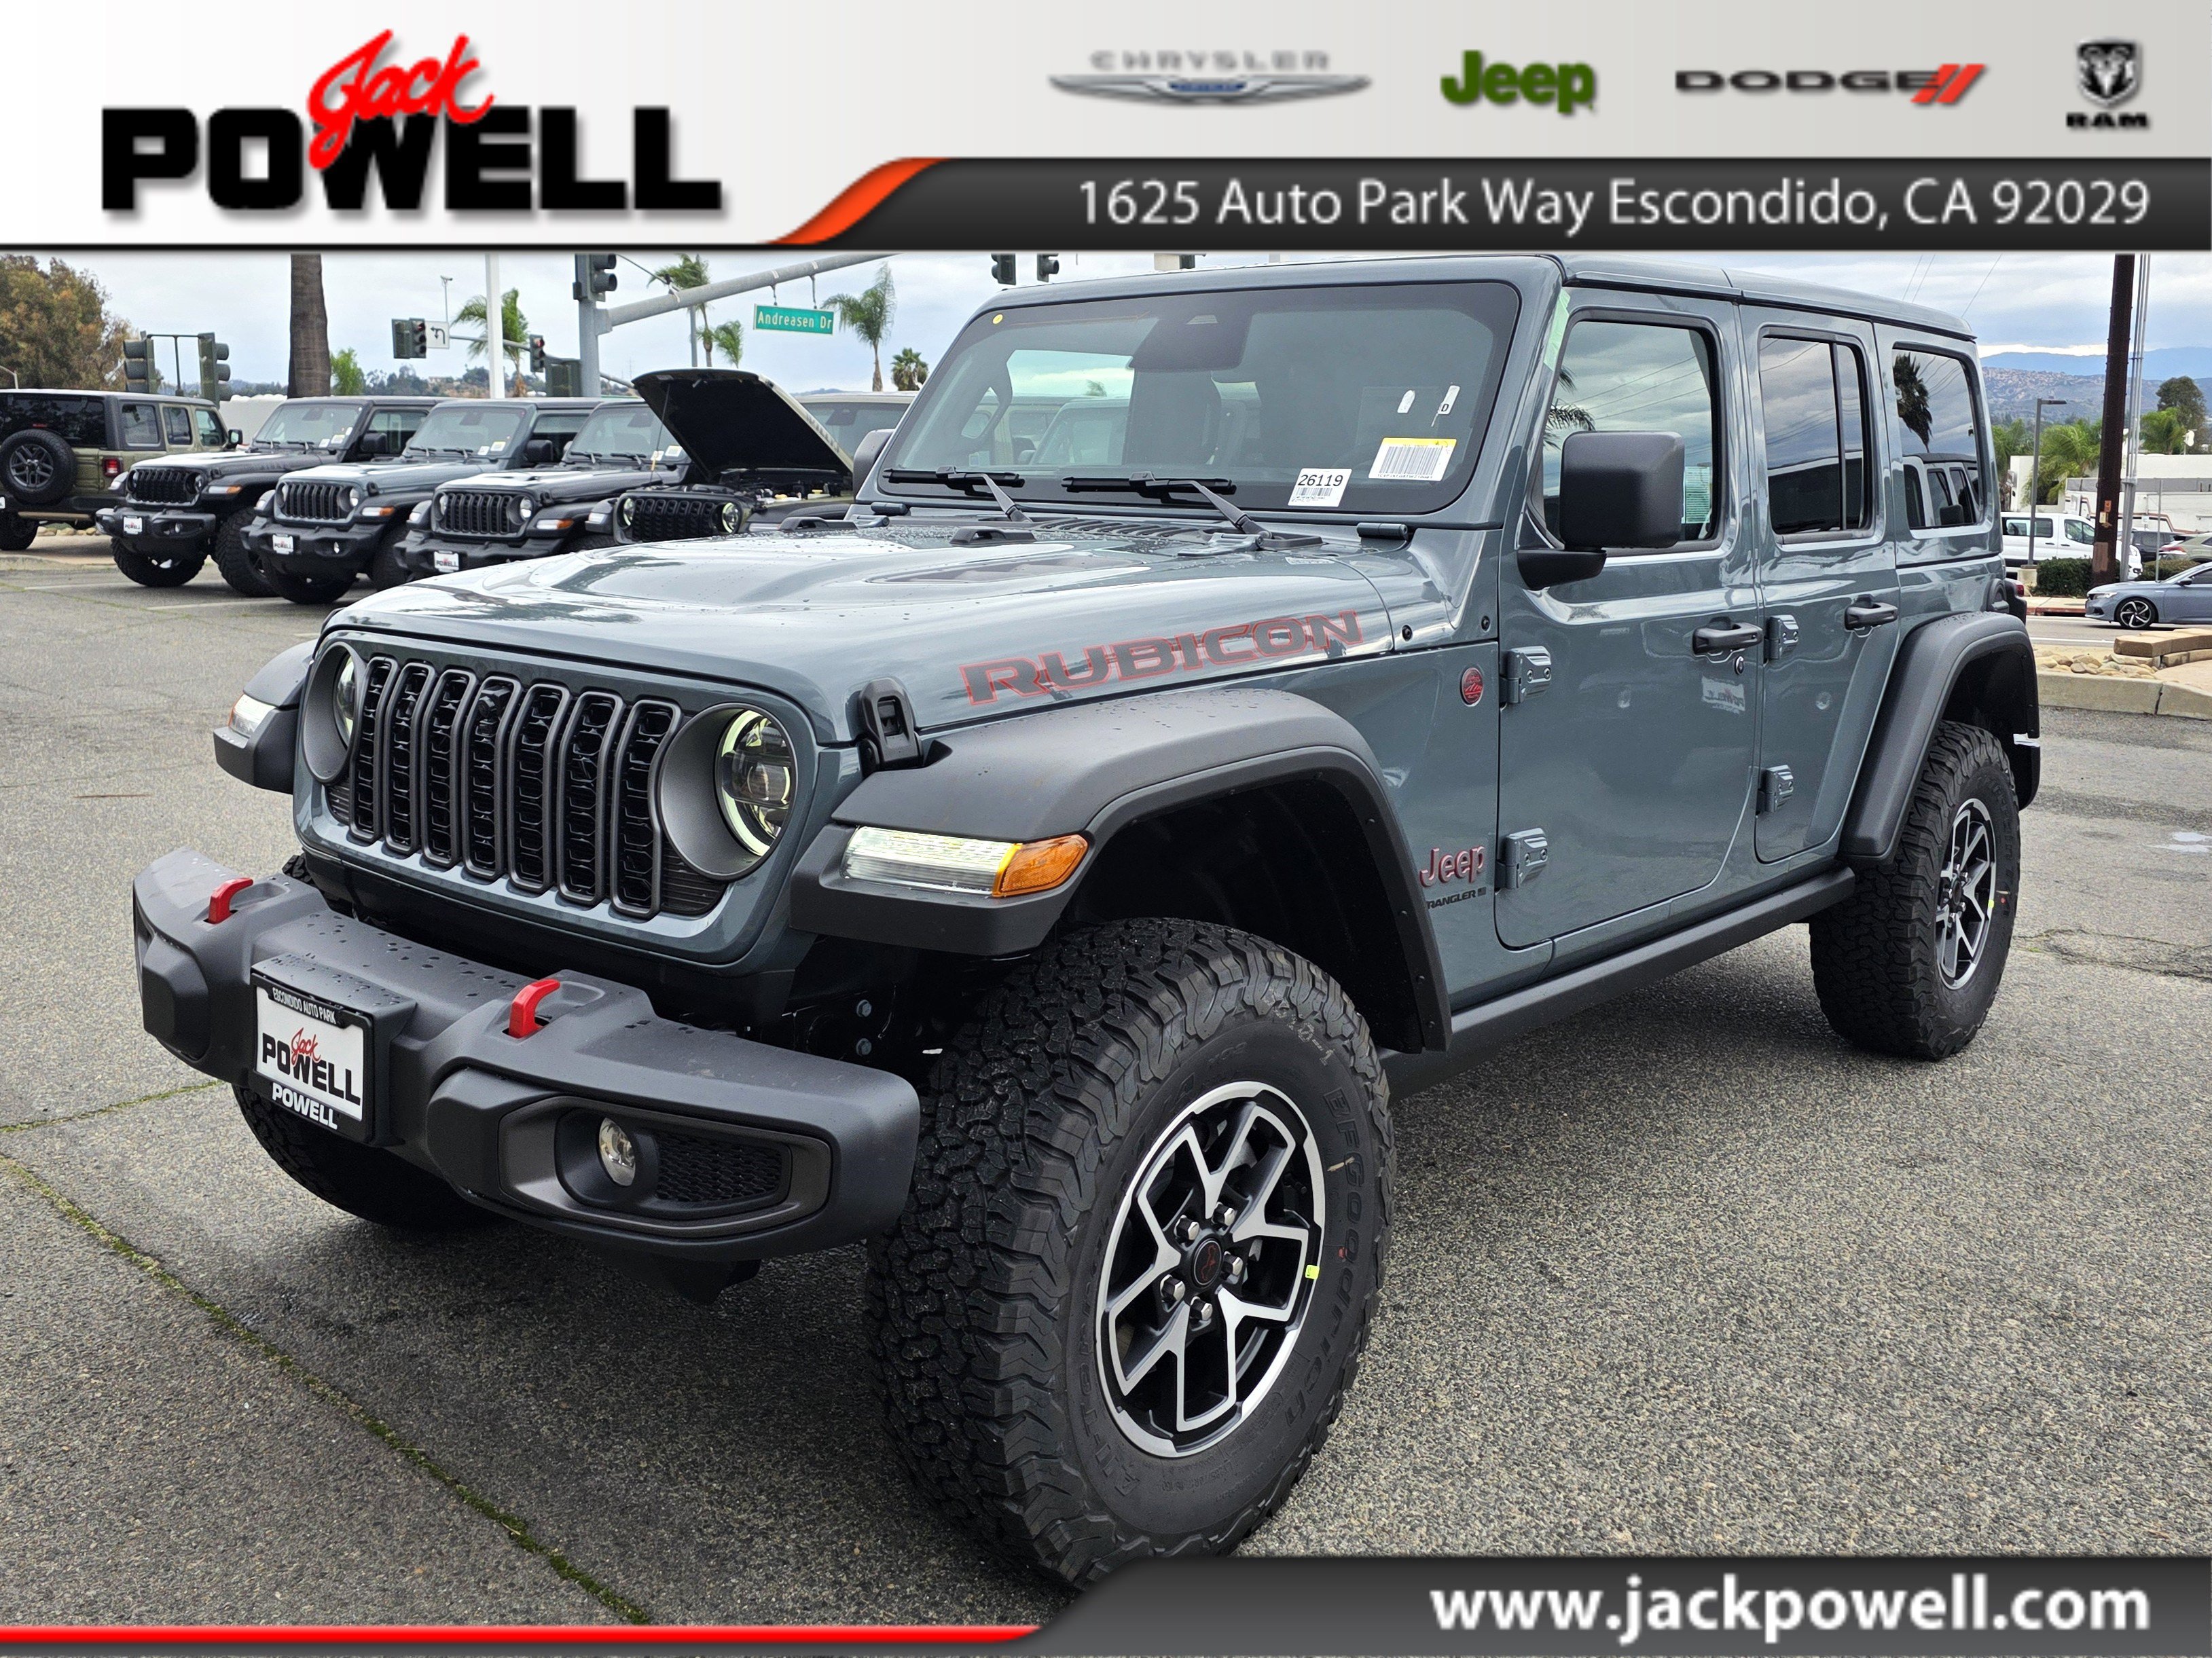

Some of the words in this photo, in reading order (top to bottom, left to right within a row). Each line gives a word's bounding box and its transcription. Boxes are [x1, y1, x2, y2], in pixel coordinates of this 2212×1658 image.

[757, 310, 814, 328] Andreasen
[820, 315, 833, 329] Dr
[1298, 475, 1343, 487] 26119
[959, 609, 1364, 706] RUBICON
[1419, 845, 1485, 888] Jeep
[1426, 889, 1476, 909] RANGLER
[272, 987, 302, 1012] ESCONDIDO
[303, 1001, 319, 1018] AUTO
[319, 1007, 336, 1024] PARK
[291, 1027, 321, 1066] Jack
[262, 1032, 361, 1107] POWELL
[272, 1082, 338, 1130] POWELL
